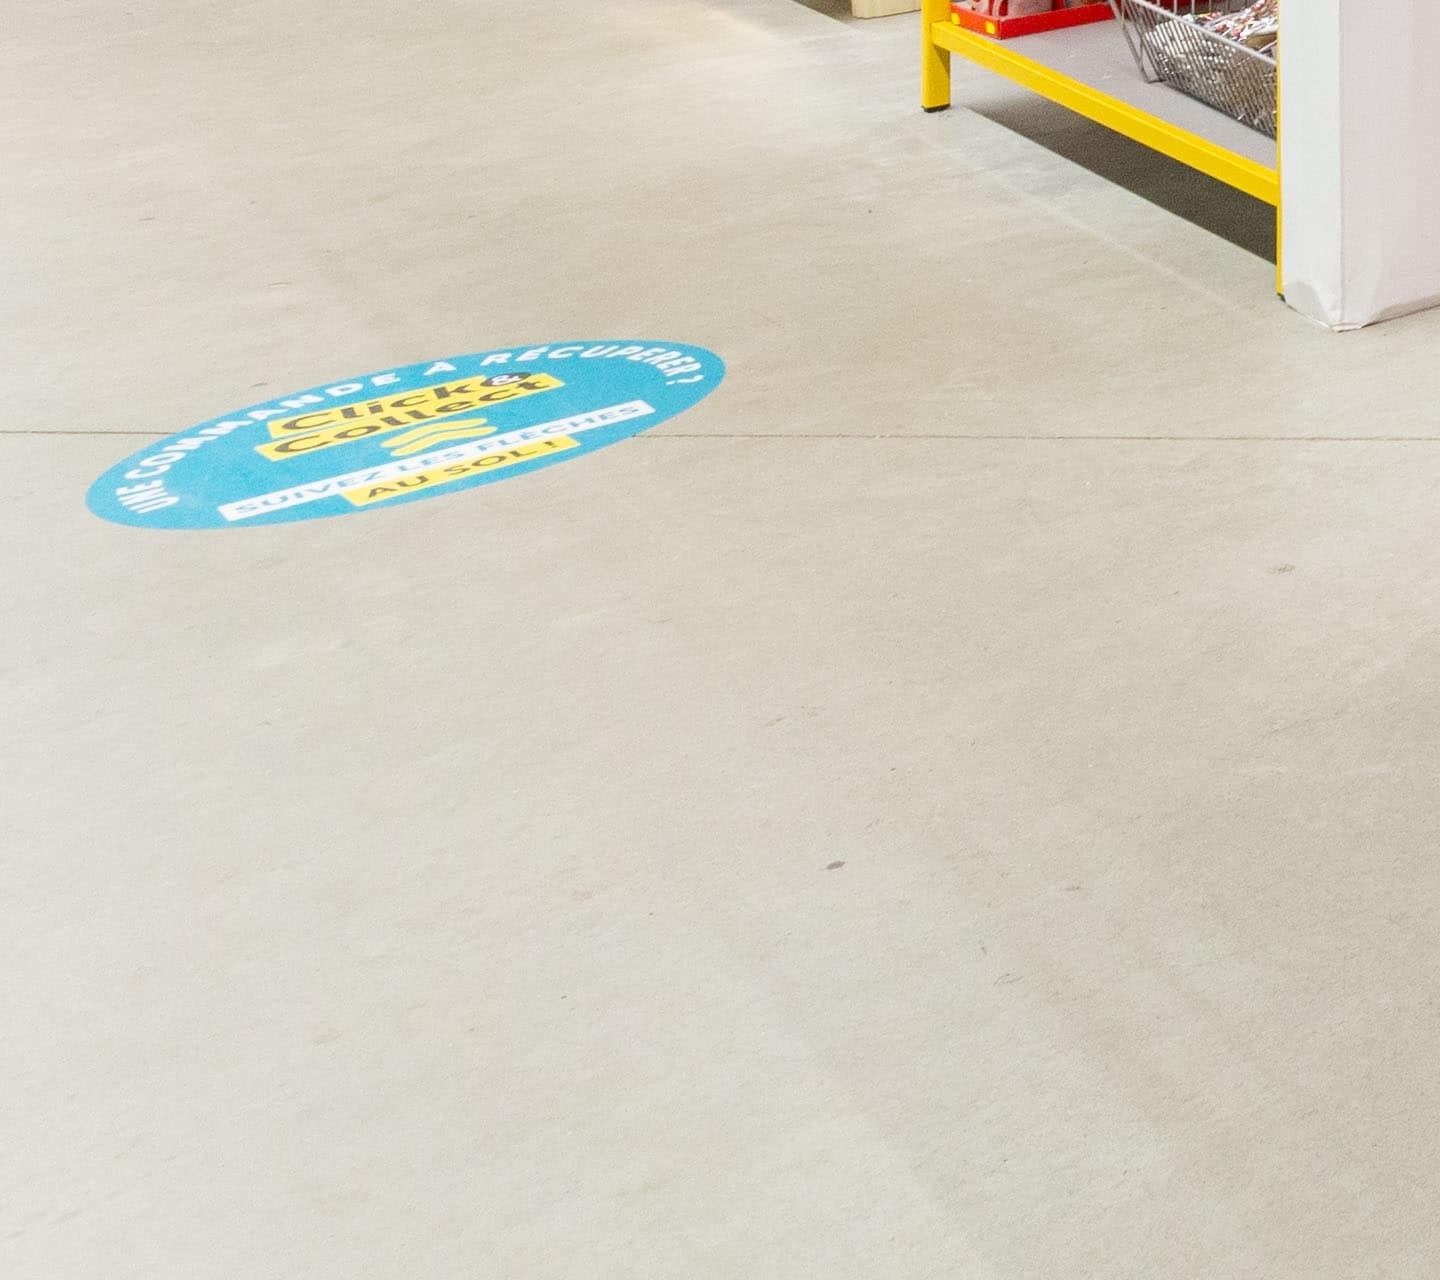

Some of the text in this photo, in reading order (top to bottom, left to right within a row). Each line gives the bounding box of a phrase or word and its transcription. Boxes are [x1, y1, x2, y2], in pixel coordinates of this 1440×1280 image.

[125, 373, 400, 480] COMMANDE
[275, 379, 552, 453] Collect
[281, 381, 473, 432] Click
[116, 479, 180, 515] UNE
[235, 468, 394, 515] SUIVEZ
[399, 449, 466, 474] LES
[367, 474, 430, 499] AU
[445, 447, 541, 476] SOL
